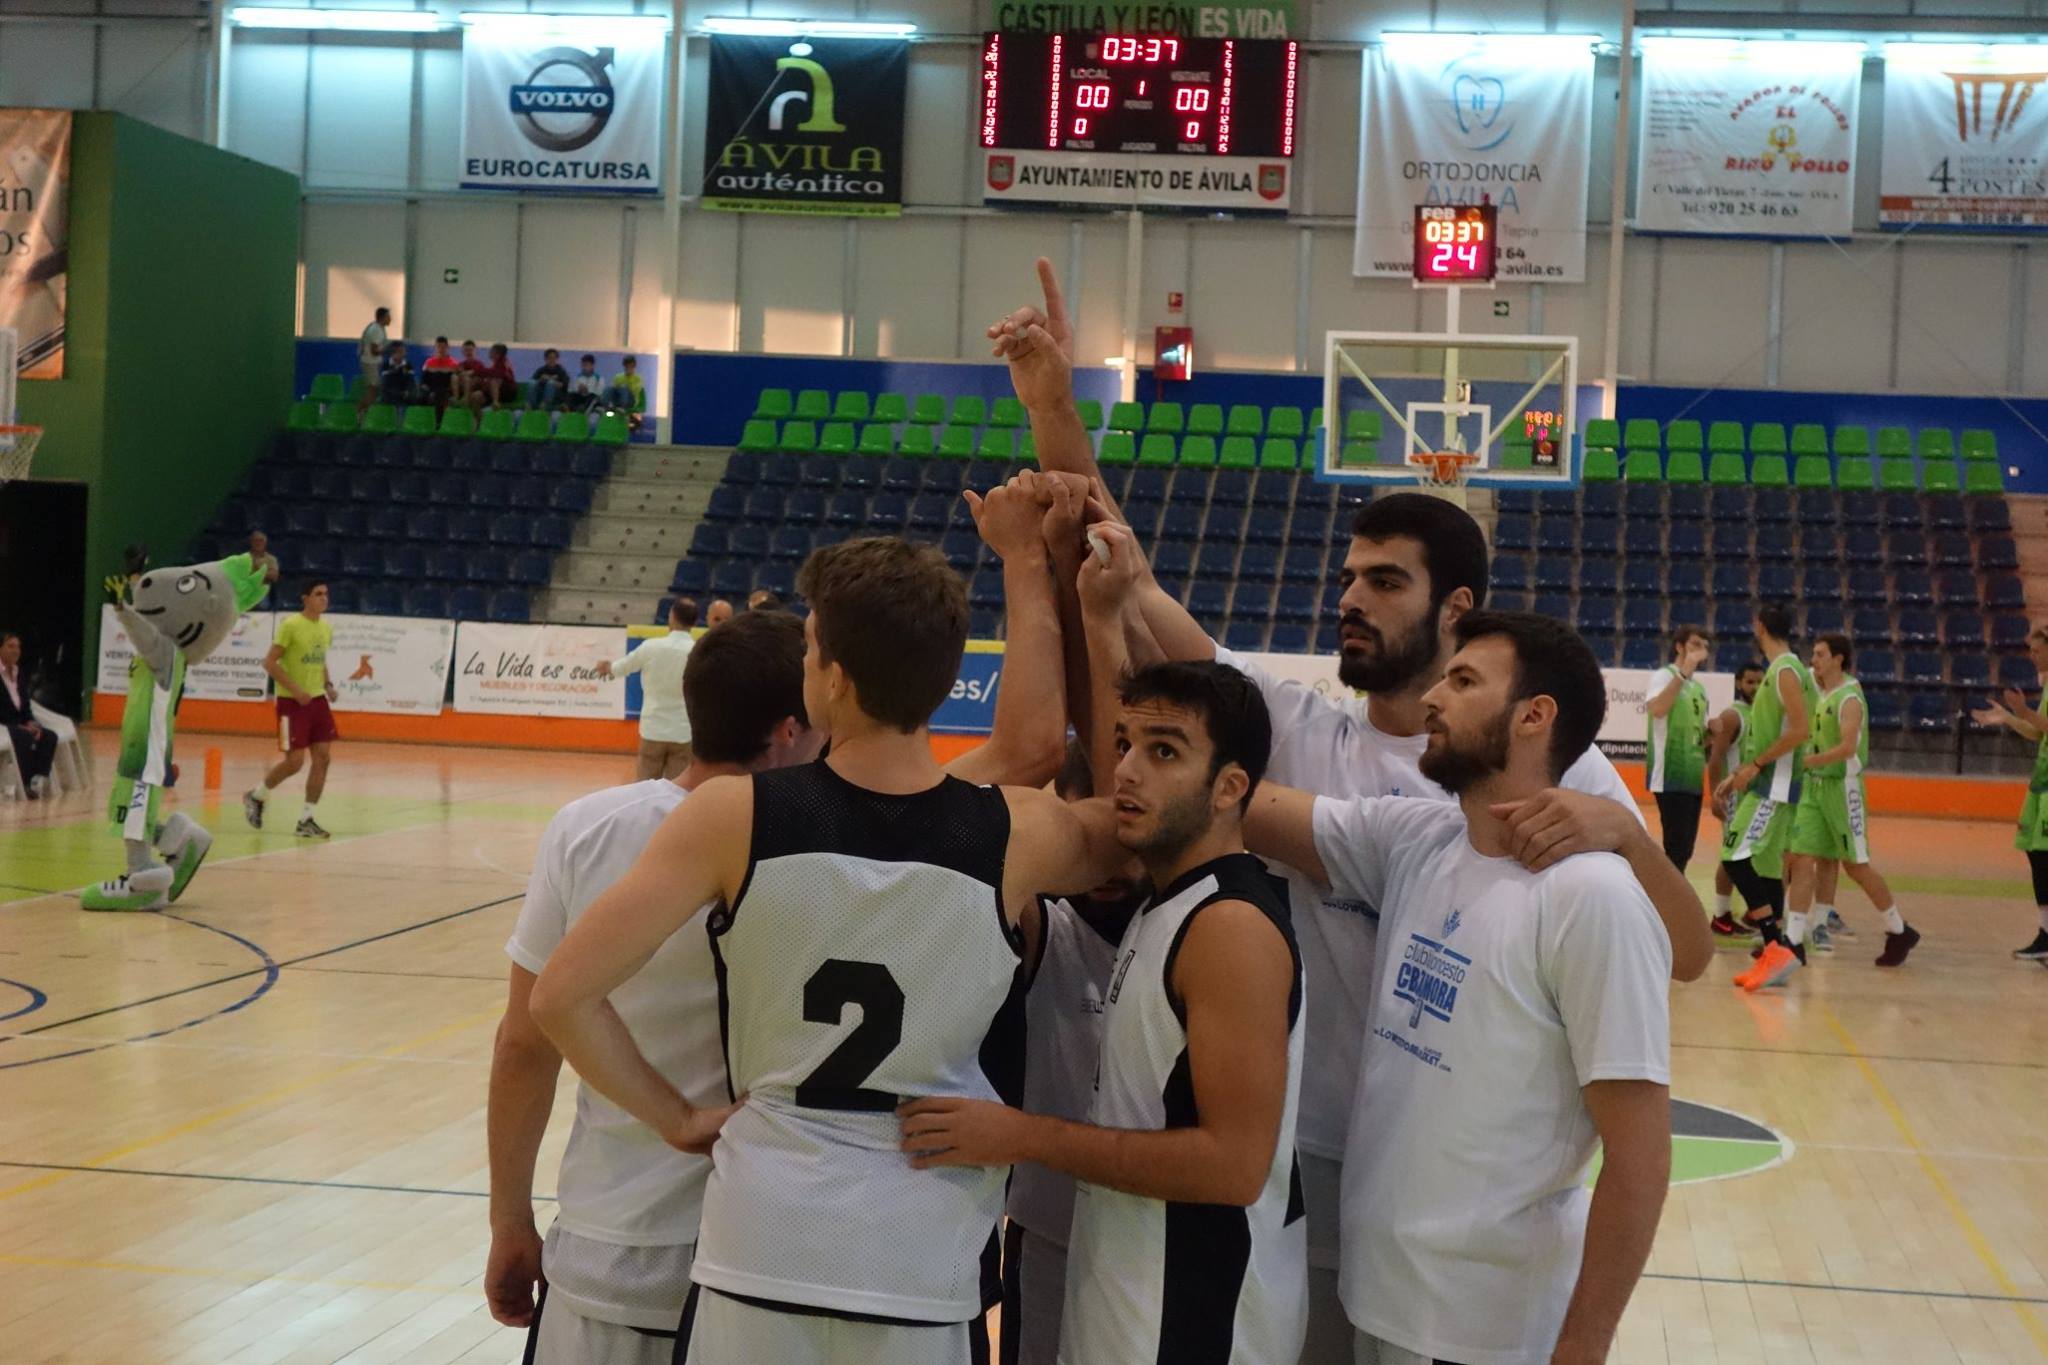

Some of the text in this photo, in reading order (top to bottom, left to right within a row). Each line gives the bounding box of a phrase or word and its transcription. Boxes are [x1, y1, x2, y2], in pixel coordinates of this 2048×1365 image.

[1001, 3, 1288, 38] CASTILLA Y LEÓN ES VIDA
[1103, 37, 1178, 61] 03:37
[1076, 85, 1110, 108] 00
[1139, 80, 1145, 95] 1
[516, 91, 608, 108] VOLVO
[1175, 88, 1209, 111] 00
[1074, 118, 1087, 134] 0
[1186, 121, 1199, 138] 0
[721, 135, 883, 172] ÁVILA
[466, 158, 652, 180] EUROCATURSA
[1018, 164, 1253, 192] AYUNTAMIENTO DE ÁVILA
[1928, 155, 1956, 194] 4
[717, 171, 885, 194] auténtica
[1432, 243, 1477, 272] 24
[463, 650, 485, 676] La
[495, 650, 534, 679] Vida
[540, 664, 564, 680] es
[796, 958, 906, 1113] 2
